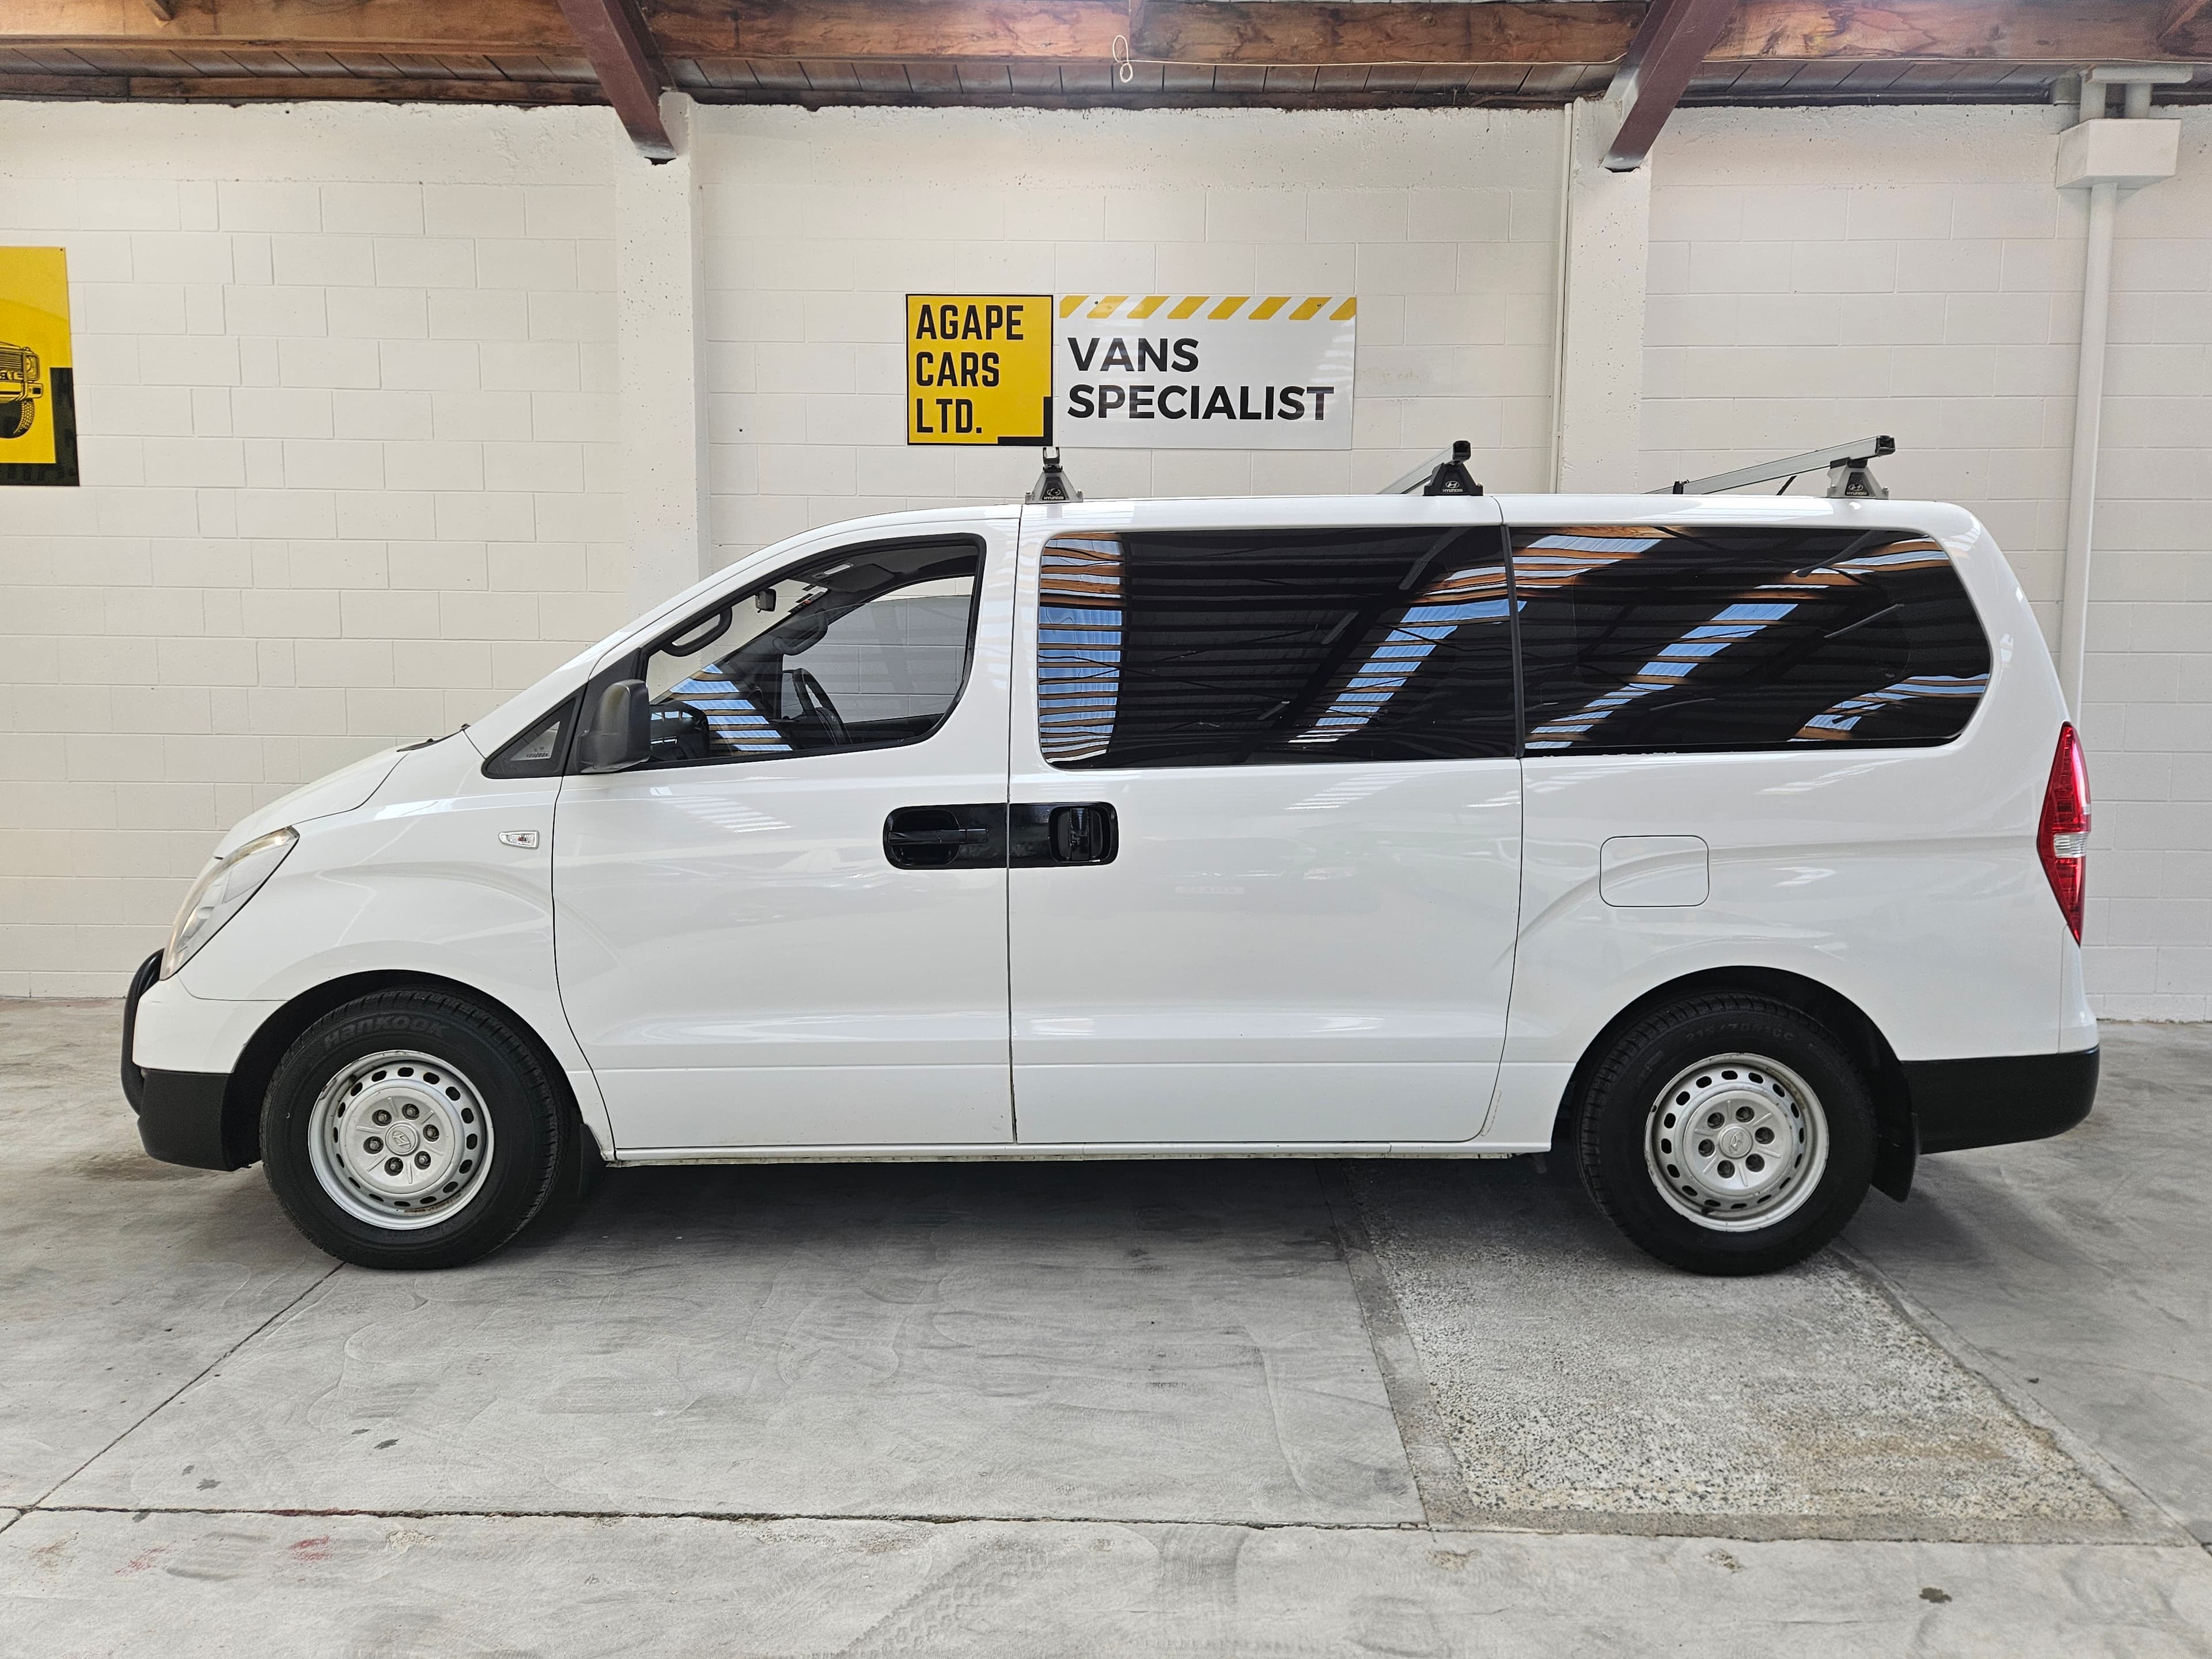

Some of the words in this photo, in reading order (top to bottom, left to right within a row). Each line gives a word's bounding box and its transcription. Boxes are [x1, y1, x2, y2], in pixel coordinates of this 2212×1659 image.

[916, 304, 1024, 340] AGAPE
[916, 351, 999, 387] CARS
[1067, 337, 1199, 372] VANS
[916, 398, 982, 434] LTD.
[1067, 384, 1334, 421] SPECIALIST
